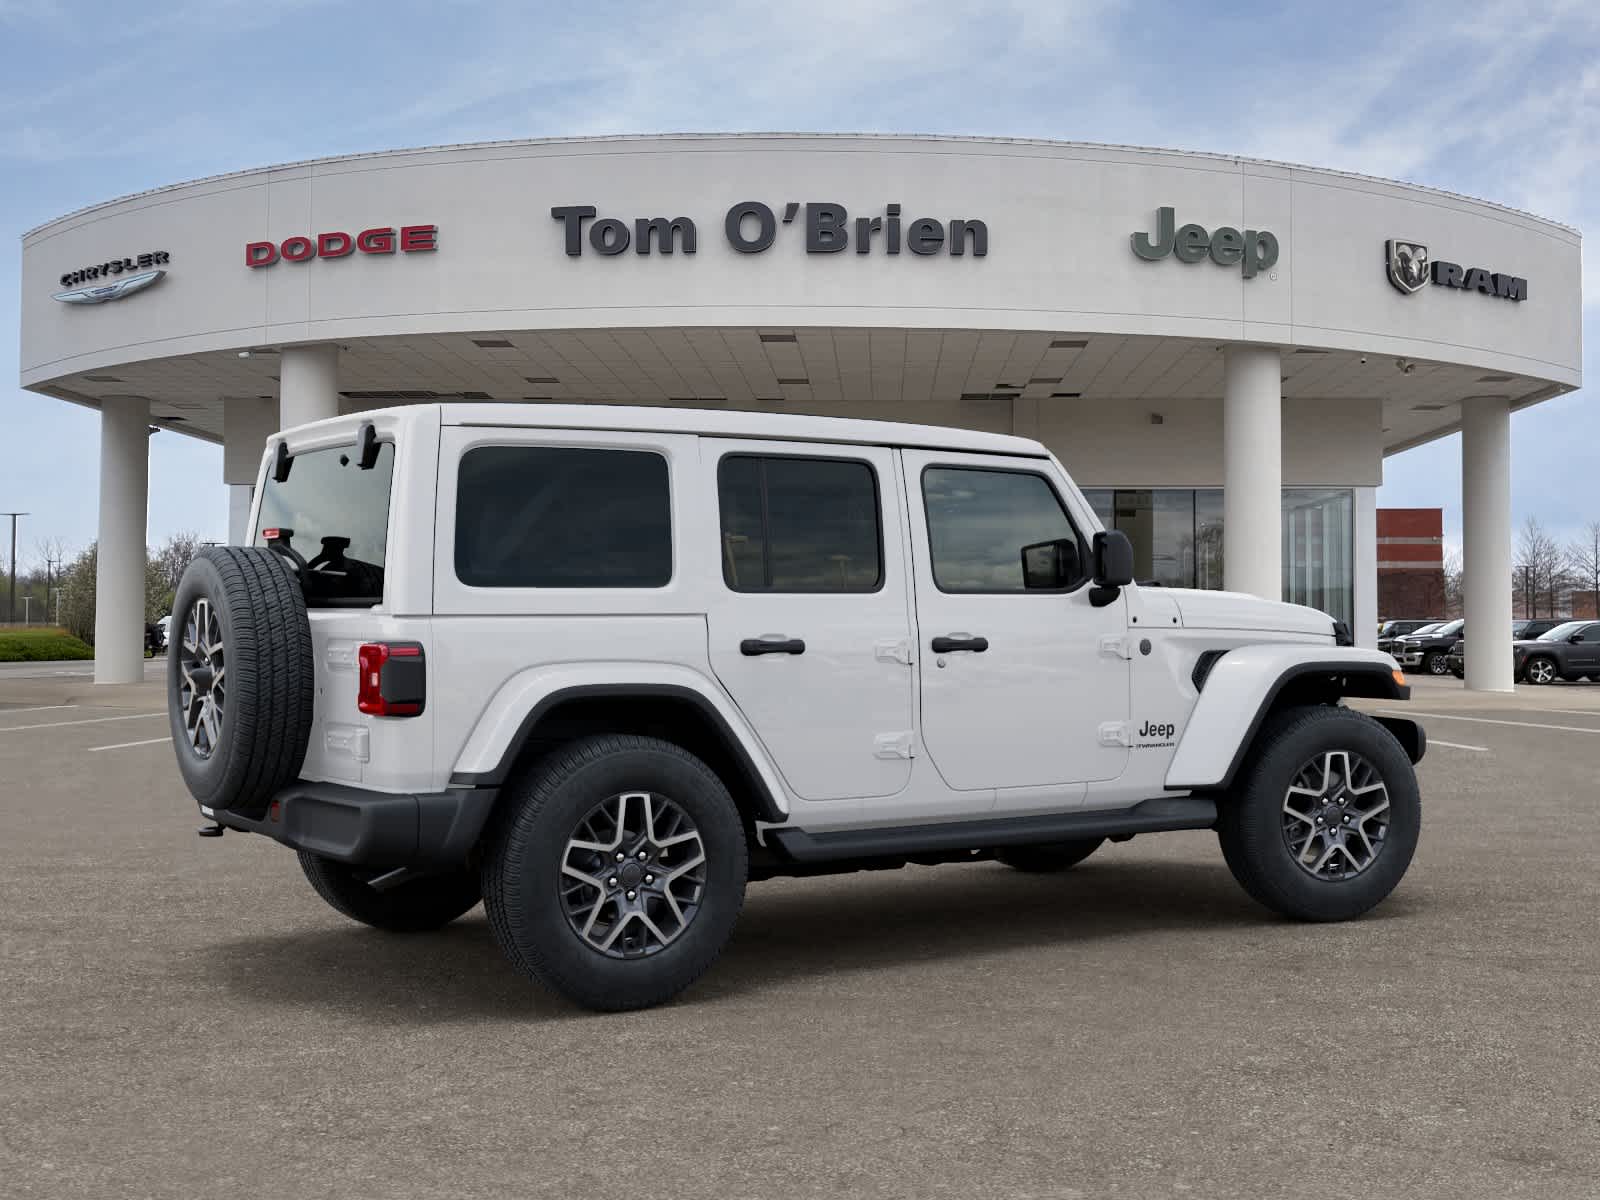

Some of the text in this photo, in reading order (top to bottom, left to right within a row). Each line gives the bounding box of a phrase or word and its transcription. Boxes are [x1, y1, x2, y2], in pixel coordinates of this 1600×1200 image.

[245, 224, 439, 269] DODGE
[551, 201, 989, 256] Tom O'Brien
[1130, 206, 1279, 279] Jeep
[60, 250, 170, 287] CHRYSLER
[1430, 261, 1527, 302] RAM
[1139, 720, 1175, 739] Jeep
